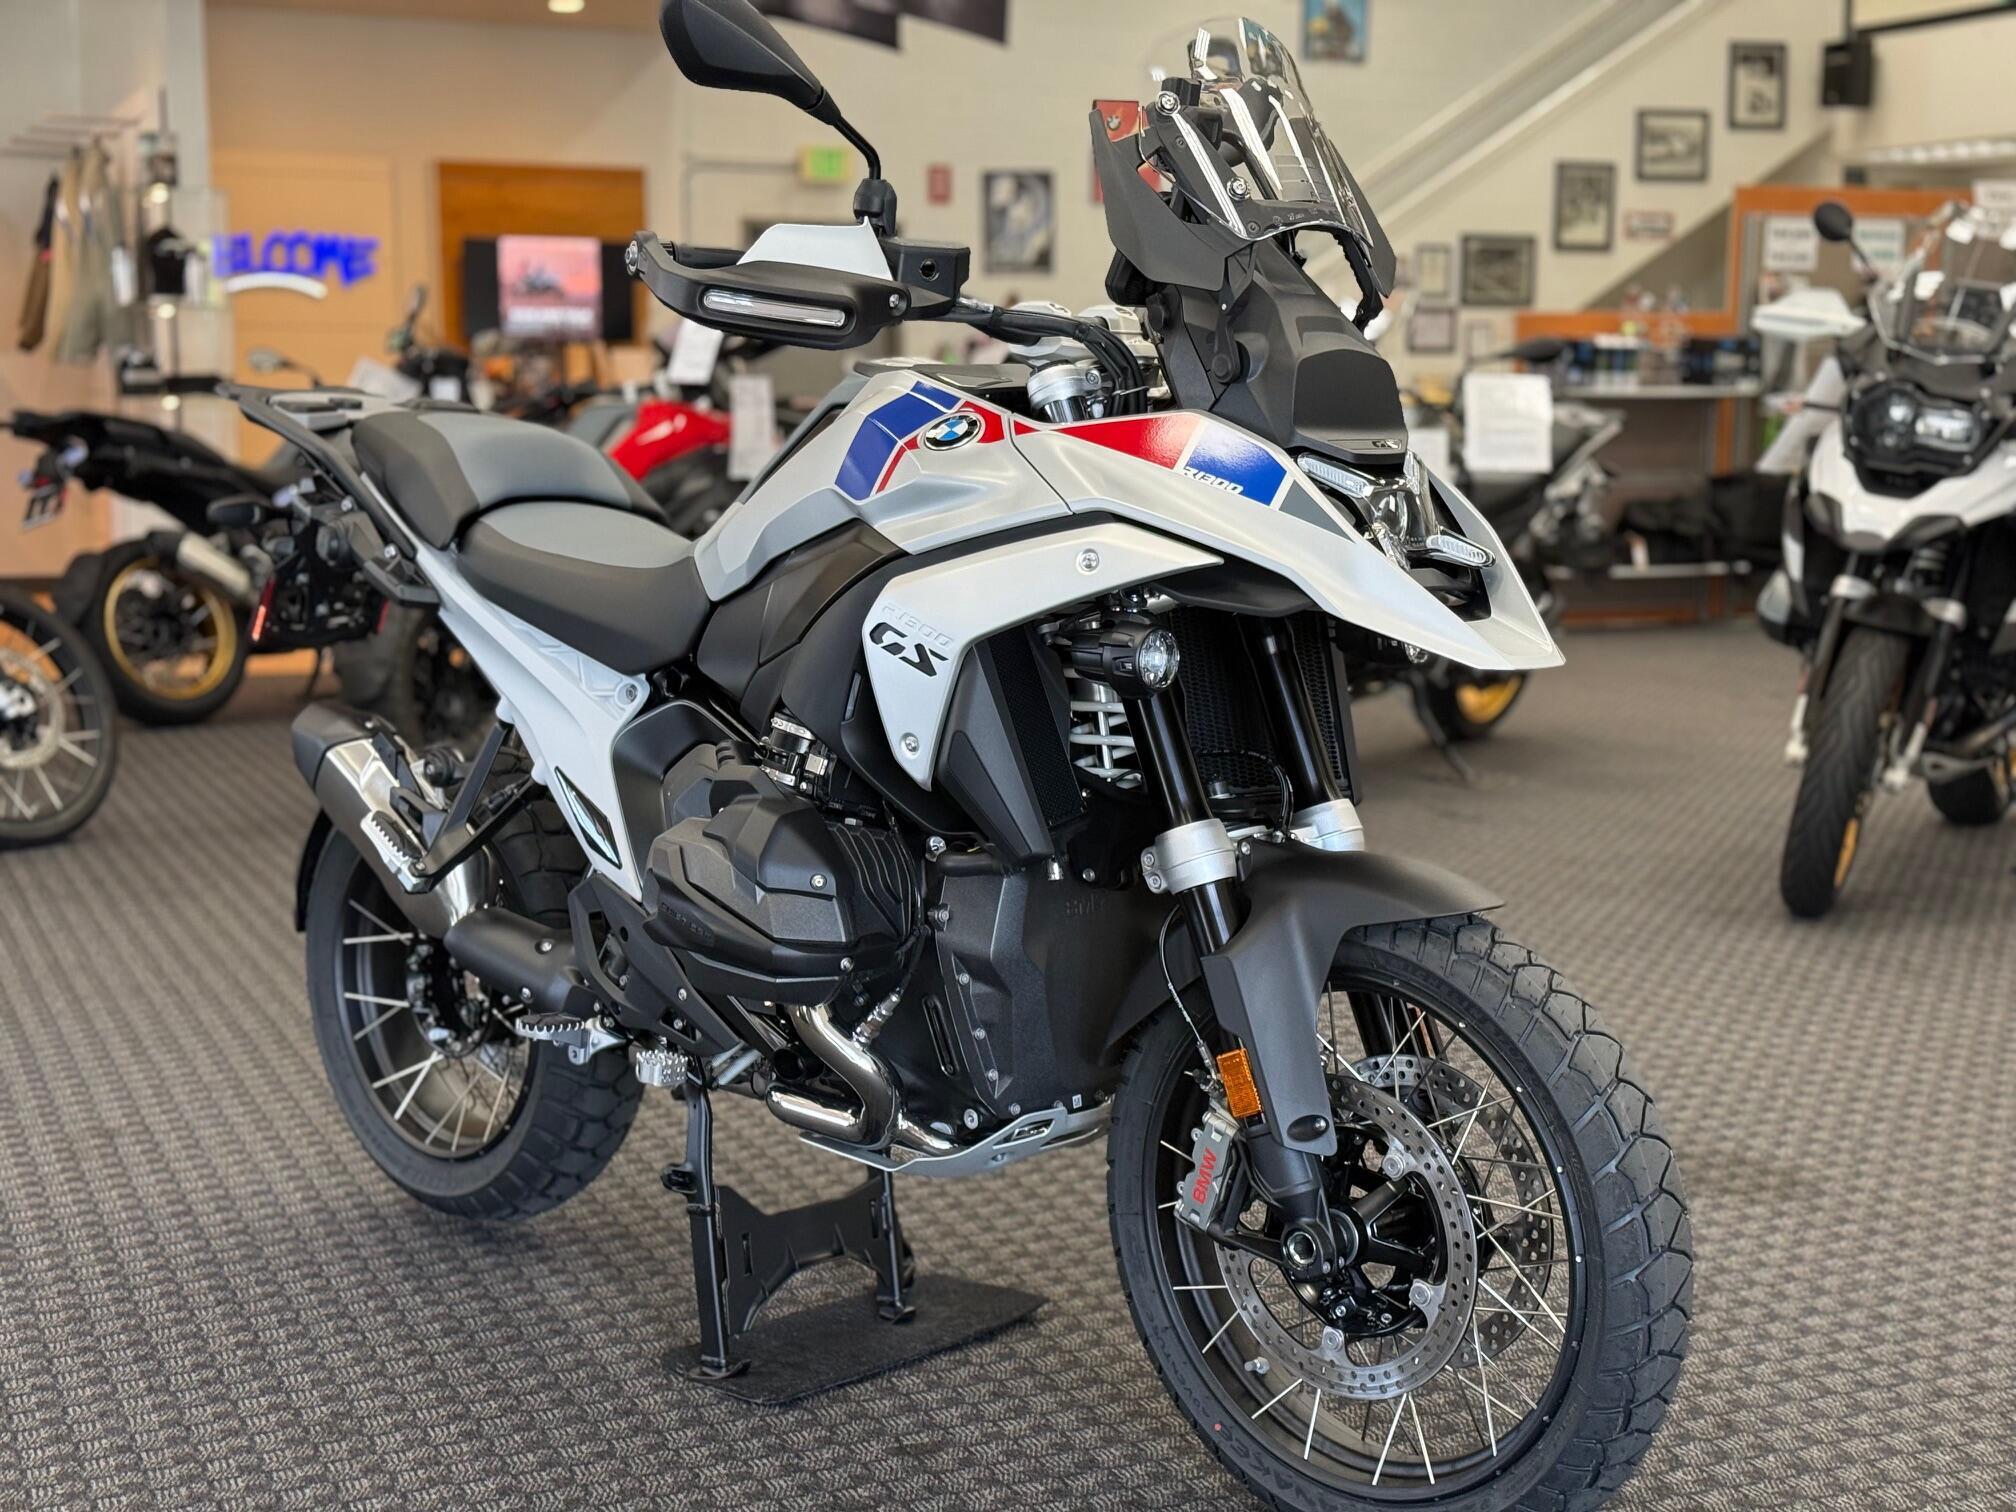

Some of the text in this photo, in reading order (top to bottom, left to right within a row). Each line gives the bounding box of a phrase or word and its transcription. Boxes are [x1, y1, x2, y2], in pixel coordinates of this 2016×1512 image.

[869, 622, 949, 678] GS
[881, 604, 954, 647] R1300
[1193, 1146, 1217, 1205] BMW
